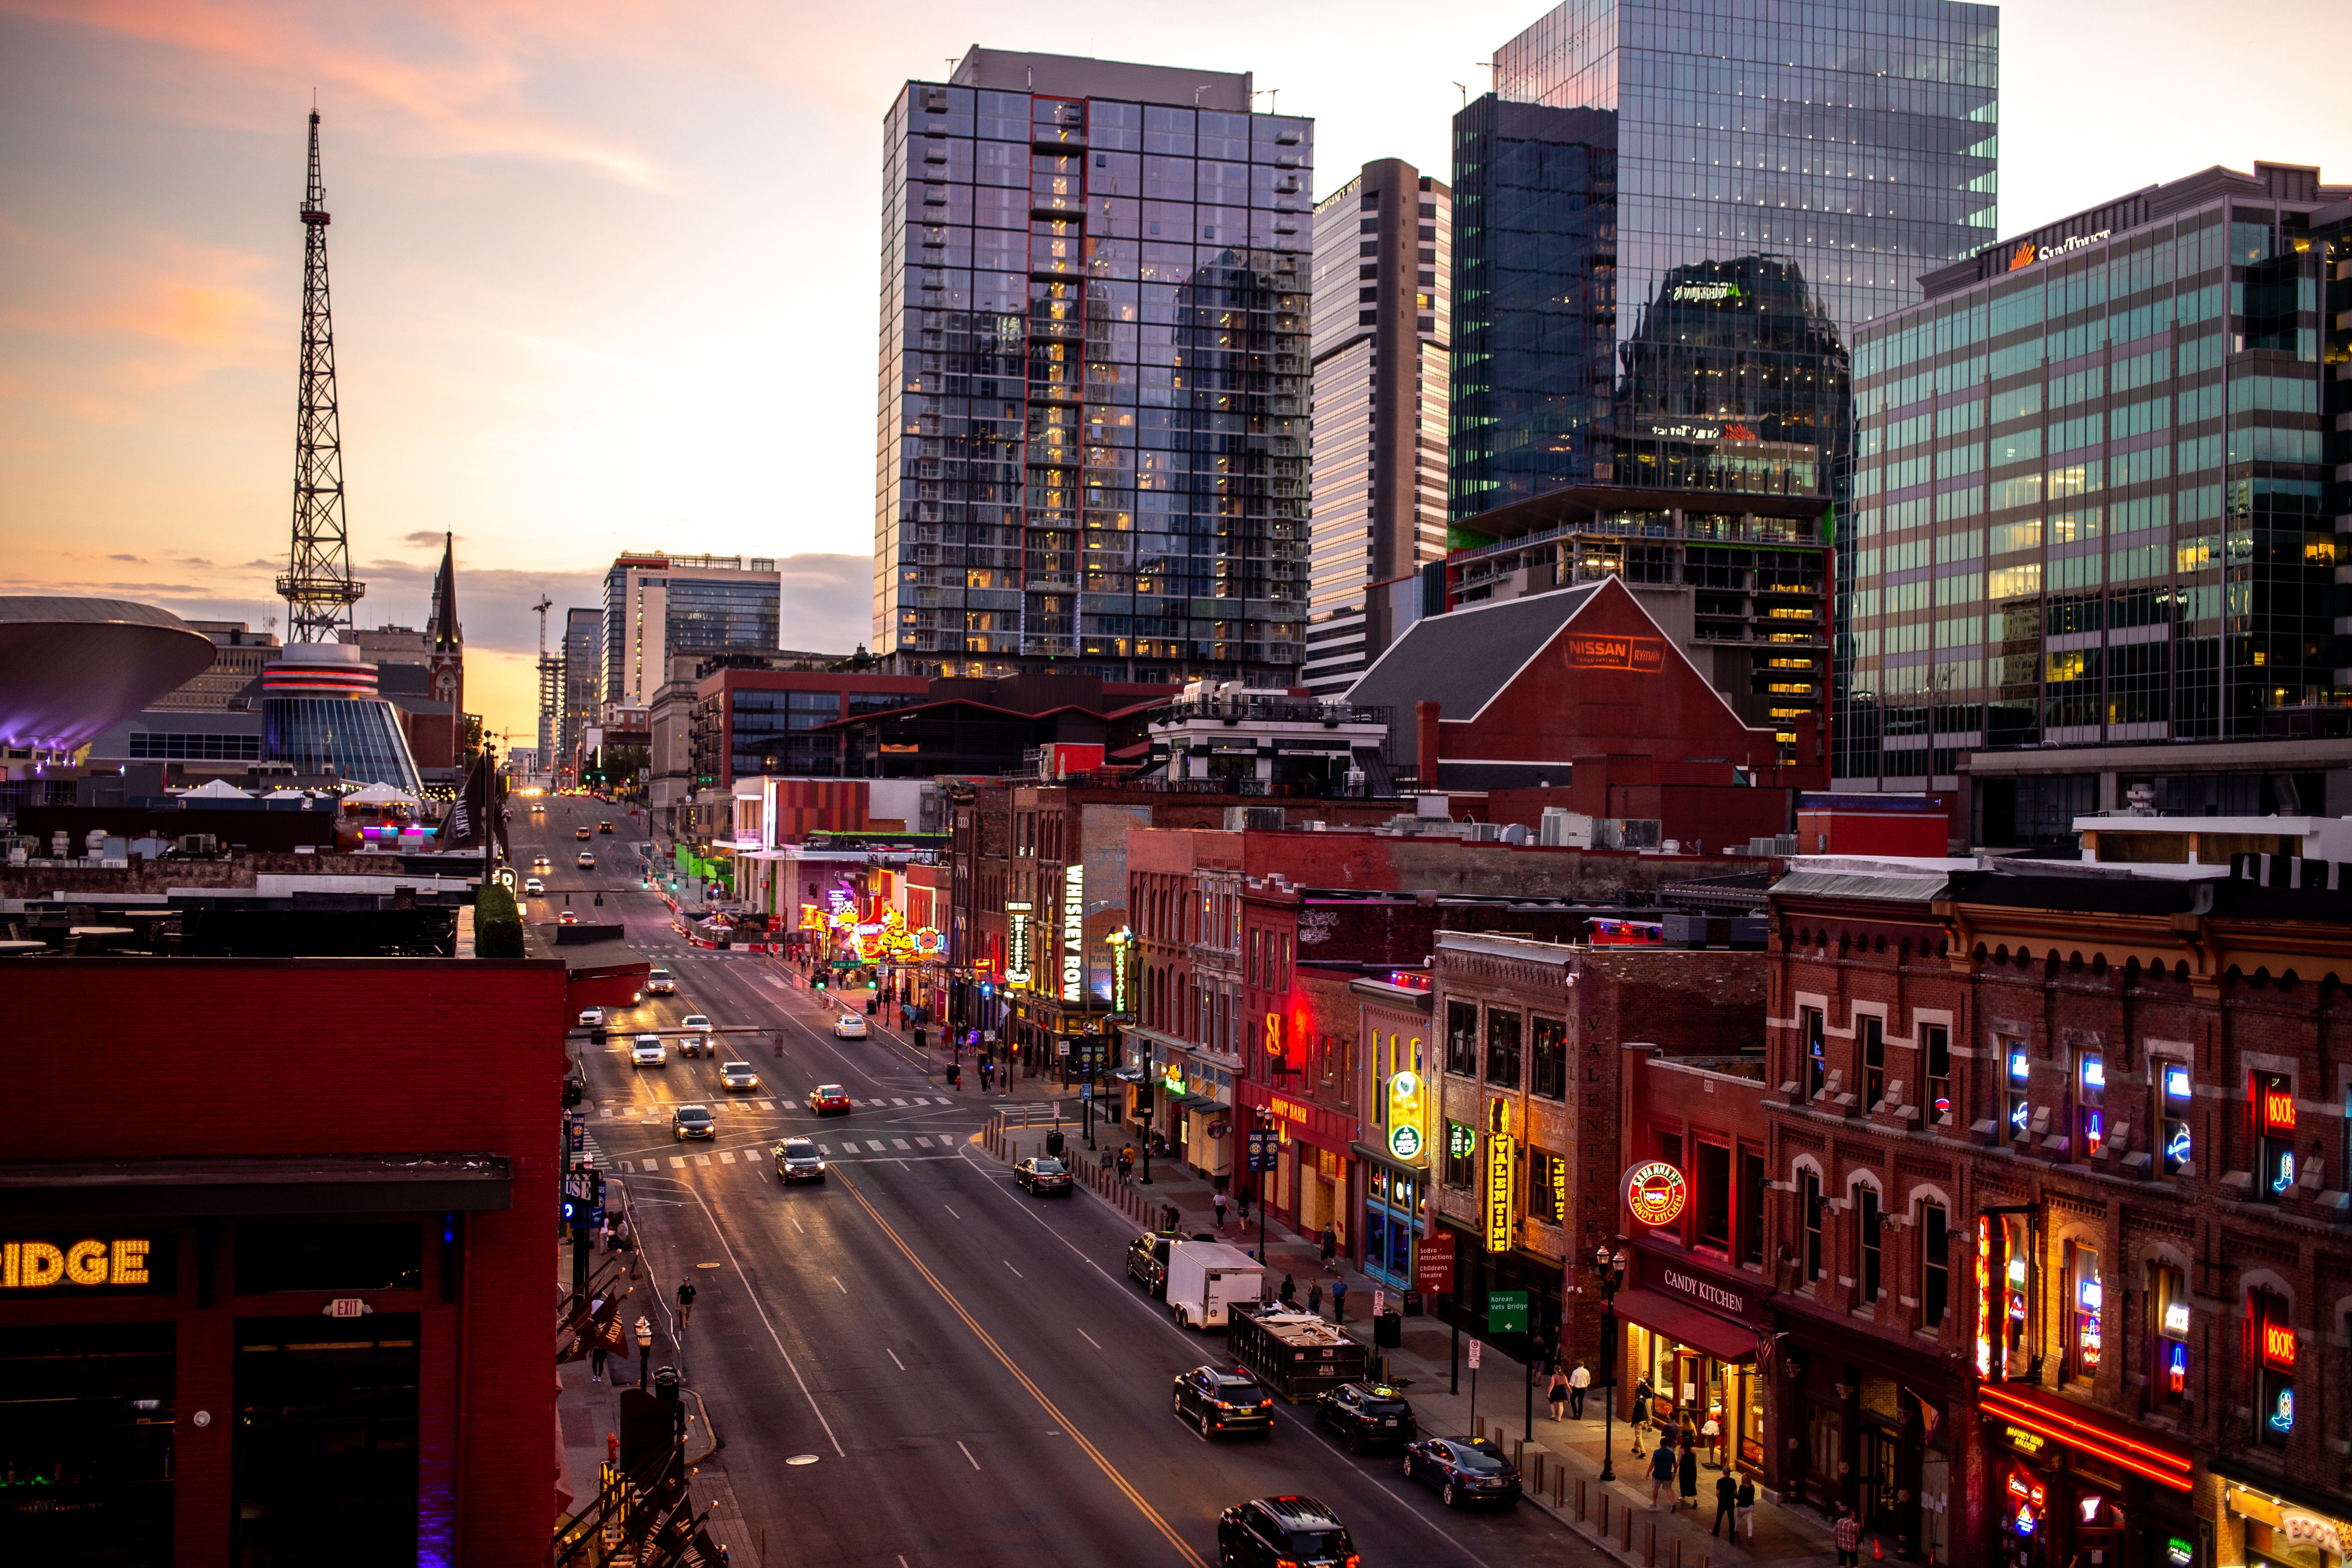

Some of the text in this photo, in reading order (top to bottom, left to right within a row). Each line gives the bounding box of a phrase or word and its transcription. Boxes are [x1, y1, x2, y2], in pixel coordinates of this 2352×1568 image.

[1569, 641, 1626, 656] NISSAN
[1634, 649, 1660, 662] RYMAN
[1014, 914, 1025, 972] WHISKEY
[1064, 864, 1084, 1002] WHISKEY ROW
[1704, 1081, 1713, 1091] 2012
[1272, 1097, 1307, 1124] BOOT BARN
[1394, 1094, 1418, 1109] Tin
[1566, 1015, 1577, 1232] VALENTINE
[1585, 1017, 1602, 1234] VALENTINE
[1633, 1164, 1682, 1187] SAVANNAH'S
[1493, 1141, 1508, 1252] VALENTINE
[1632, 1196, 1654, 1221] CANDY
[1654, 1194, 1683, 1222] KITCHEN
[0, 1240, 149, 1286] IDGE
[1665, 1270, 1743, 1312] CANDY KITCHEN
[338, 1300, 358, 1315] EXIT
[2269, 1329, 2294, 1360] BOOTS
[2006, 1427, 2044, 1447] WHISKEY BENT
[2014, 1436, 2037, 1452] SALOON
[2169, 1539, 2191, 1553] JAMESON
[2179, 1551, 2191, 1559] MUSIC
